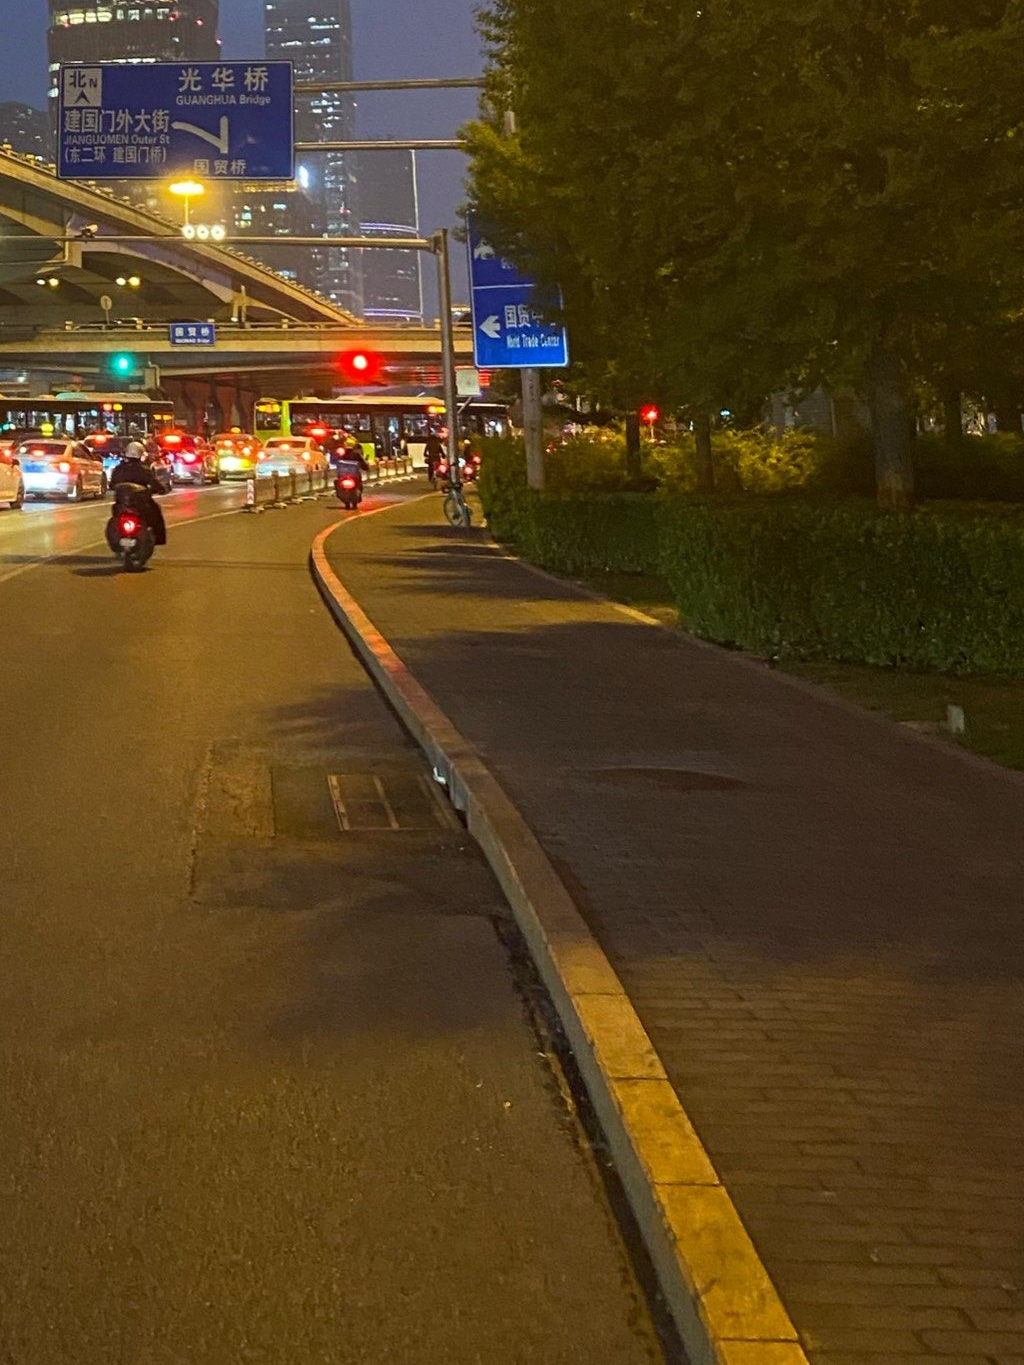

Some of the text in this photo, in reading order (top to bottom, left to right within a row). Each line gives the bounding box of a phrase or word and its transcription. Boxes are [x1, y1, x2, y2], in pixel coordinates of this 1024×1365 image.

[69, 72, 98, 88] 北 N
[178, 66, 269, 93] 光华桥
[176, 94, 271, 106] GUANGHUA Bridge
[64, 109, 169, 133] 建国门外大街
[63, 134, 171, 145] JIANGUOMEN Outer St
[193, 158, 247, 175] 国贸桥
[175, 327, 209, 337] 国贸桥
[522, 334, 538, 347] Trade
